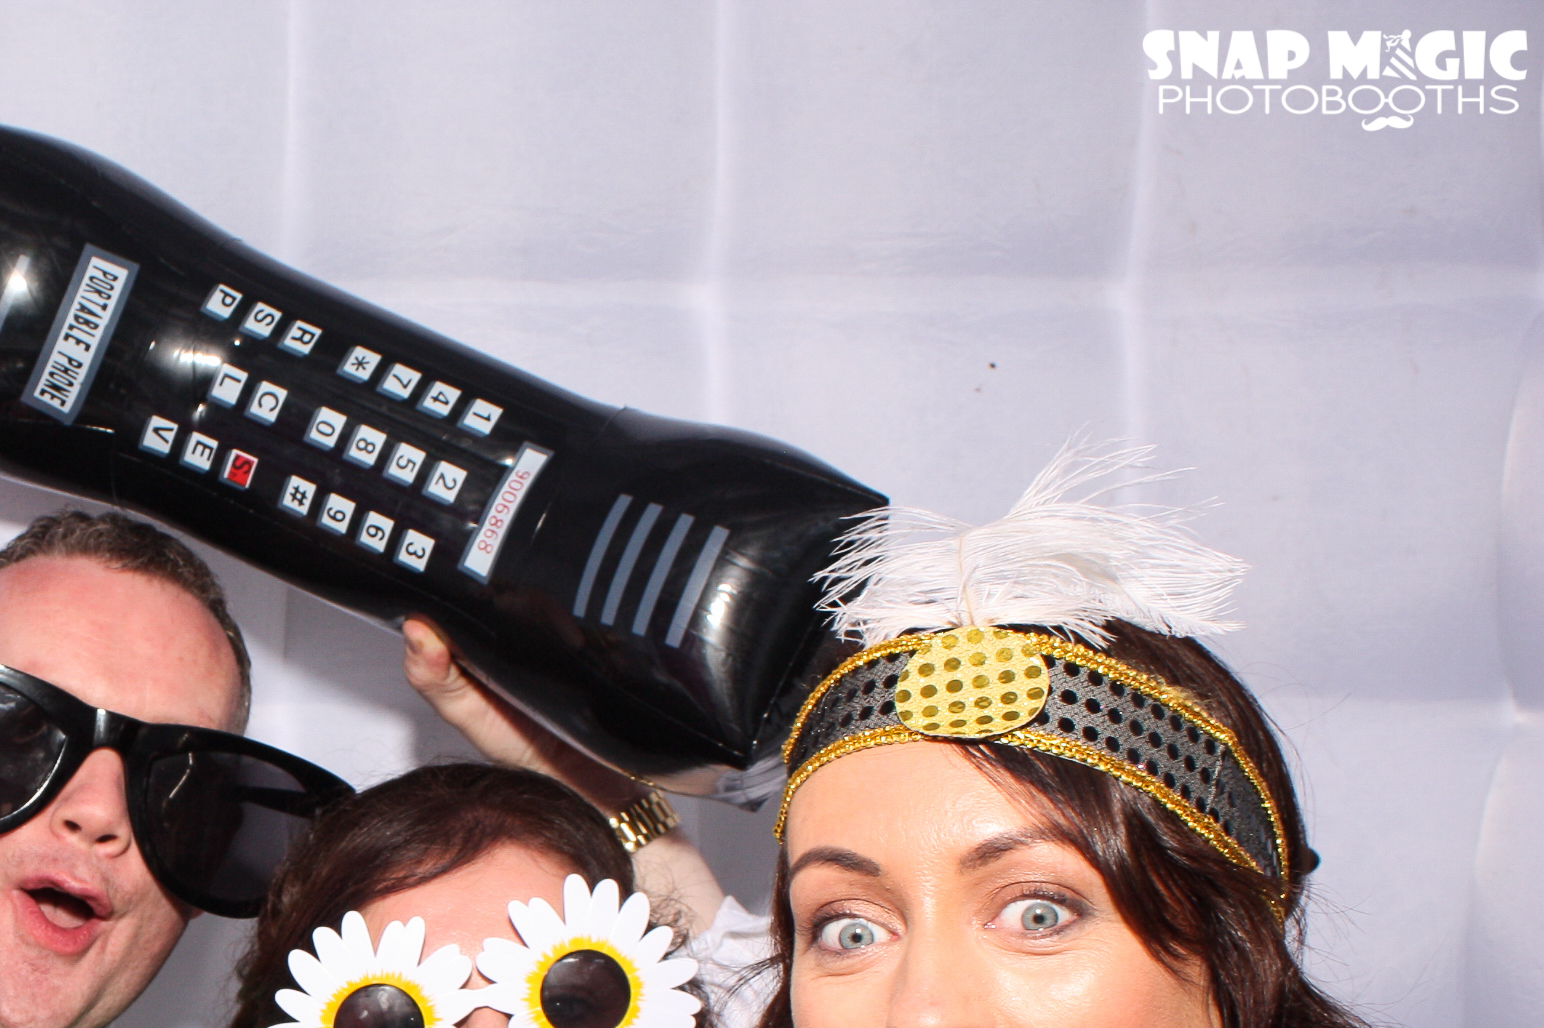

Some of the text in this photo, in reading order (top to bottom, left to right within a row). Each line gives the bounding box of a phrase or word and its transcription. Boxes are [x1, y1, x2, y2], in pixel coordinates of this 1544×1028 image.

[39, 265, 119, 408] PORTABLE PHONE
[151, 288, 238, 445] P V
[191, 308, 276, 462] S L E
[257, 391, 280, 412] C
[290, 326, 316, 346] R
[315, 420, 336, 437] 0
[326, 373, 412, 523] 7 8 9
[365, 391, 450, 541] 4 5 6
[405, 411, 491, 560] 1 2 3
[477, 469, 531, 554] 9006868
